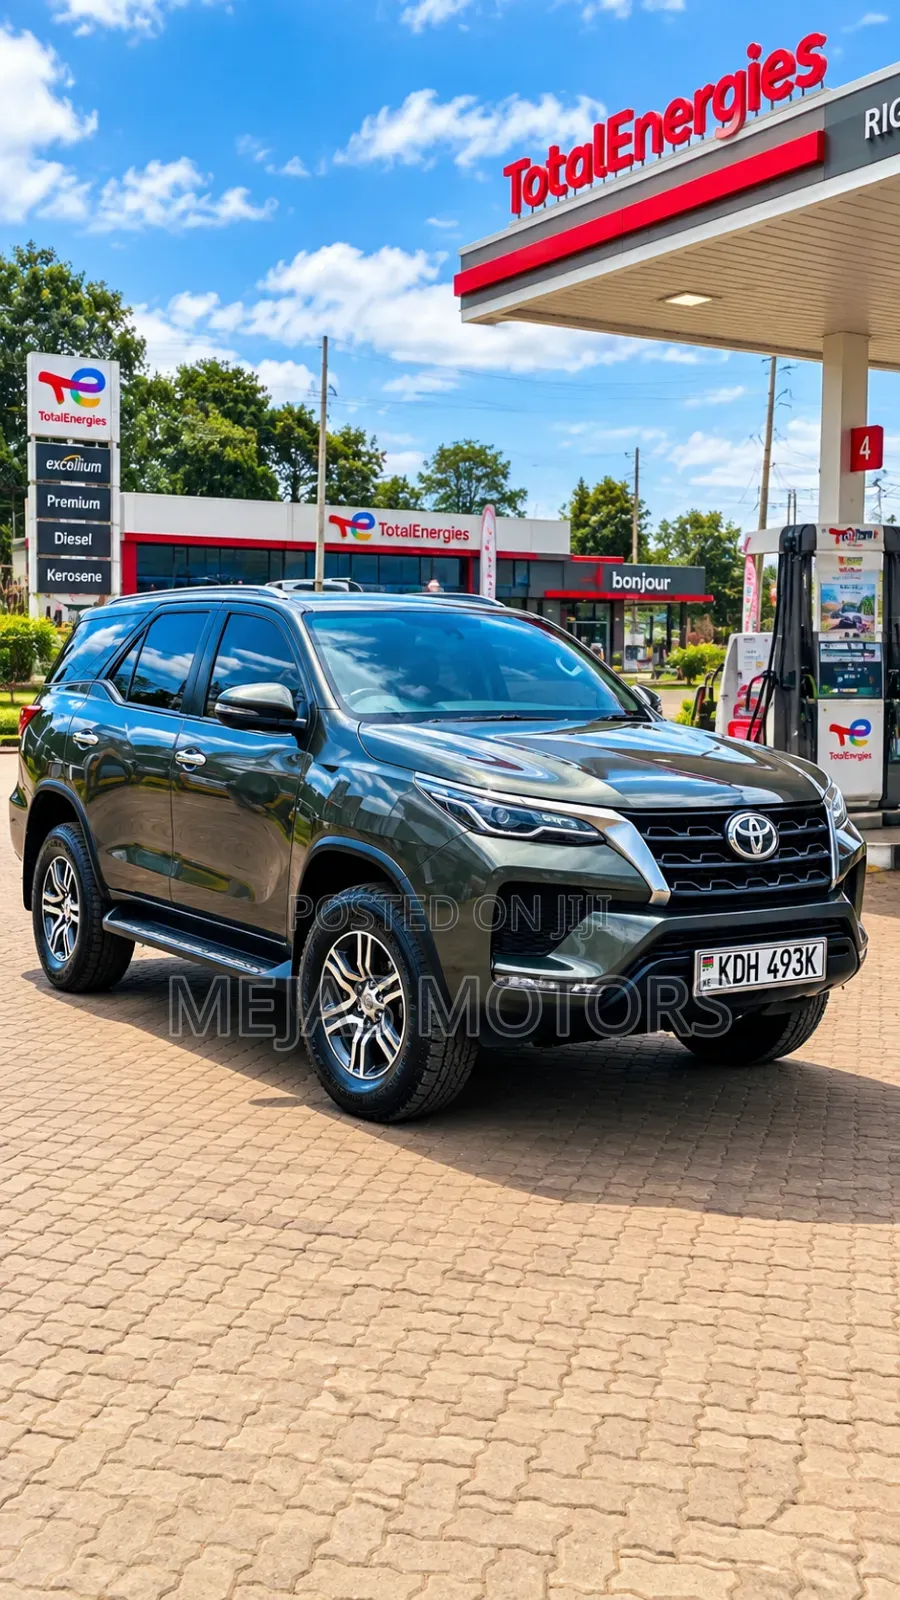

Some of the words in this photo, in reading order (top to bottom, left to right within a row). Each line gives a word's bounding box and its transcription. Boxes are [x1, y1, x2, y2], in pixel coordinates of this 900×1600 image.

[503, 32, 828, 214] TotalEnergies
[38, 410, 107, 427] TotalEnergies
[859, 435, 871, 461] 4
[47, 494, 101, 510] Premium
[54, 531, 92, 546] Diesel
[378, 522, 470, 544] TotalEnergies
[47, 568, 103, 582] Kerosene
[612, 571, 671, 593] bonjour
[718, 951, 759, 986] KDH
[766, 945, 818, 979] 493K
